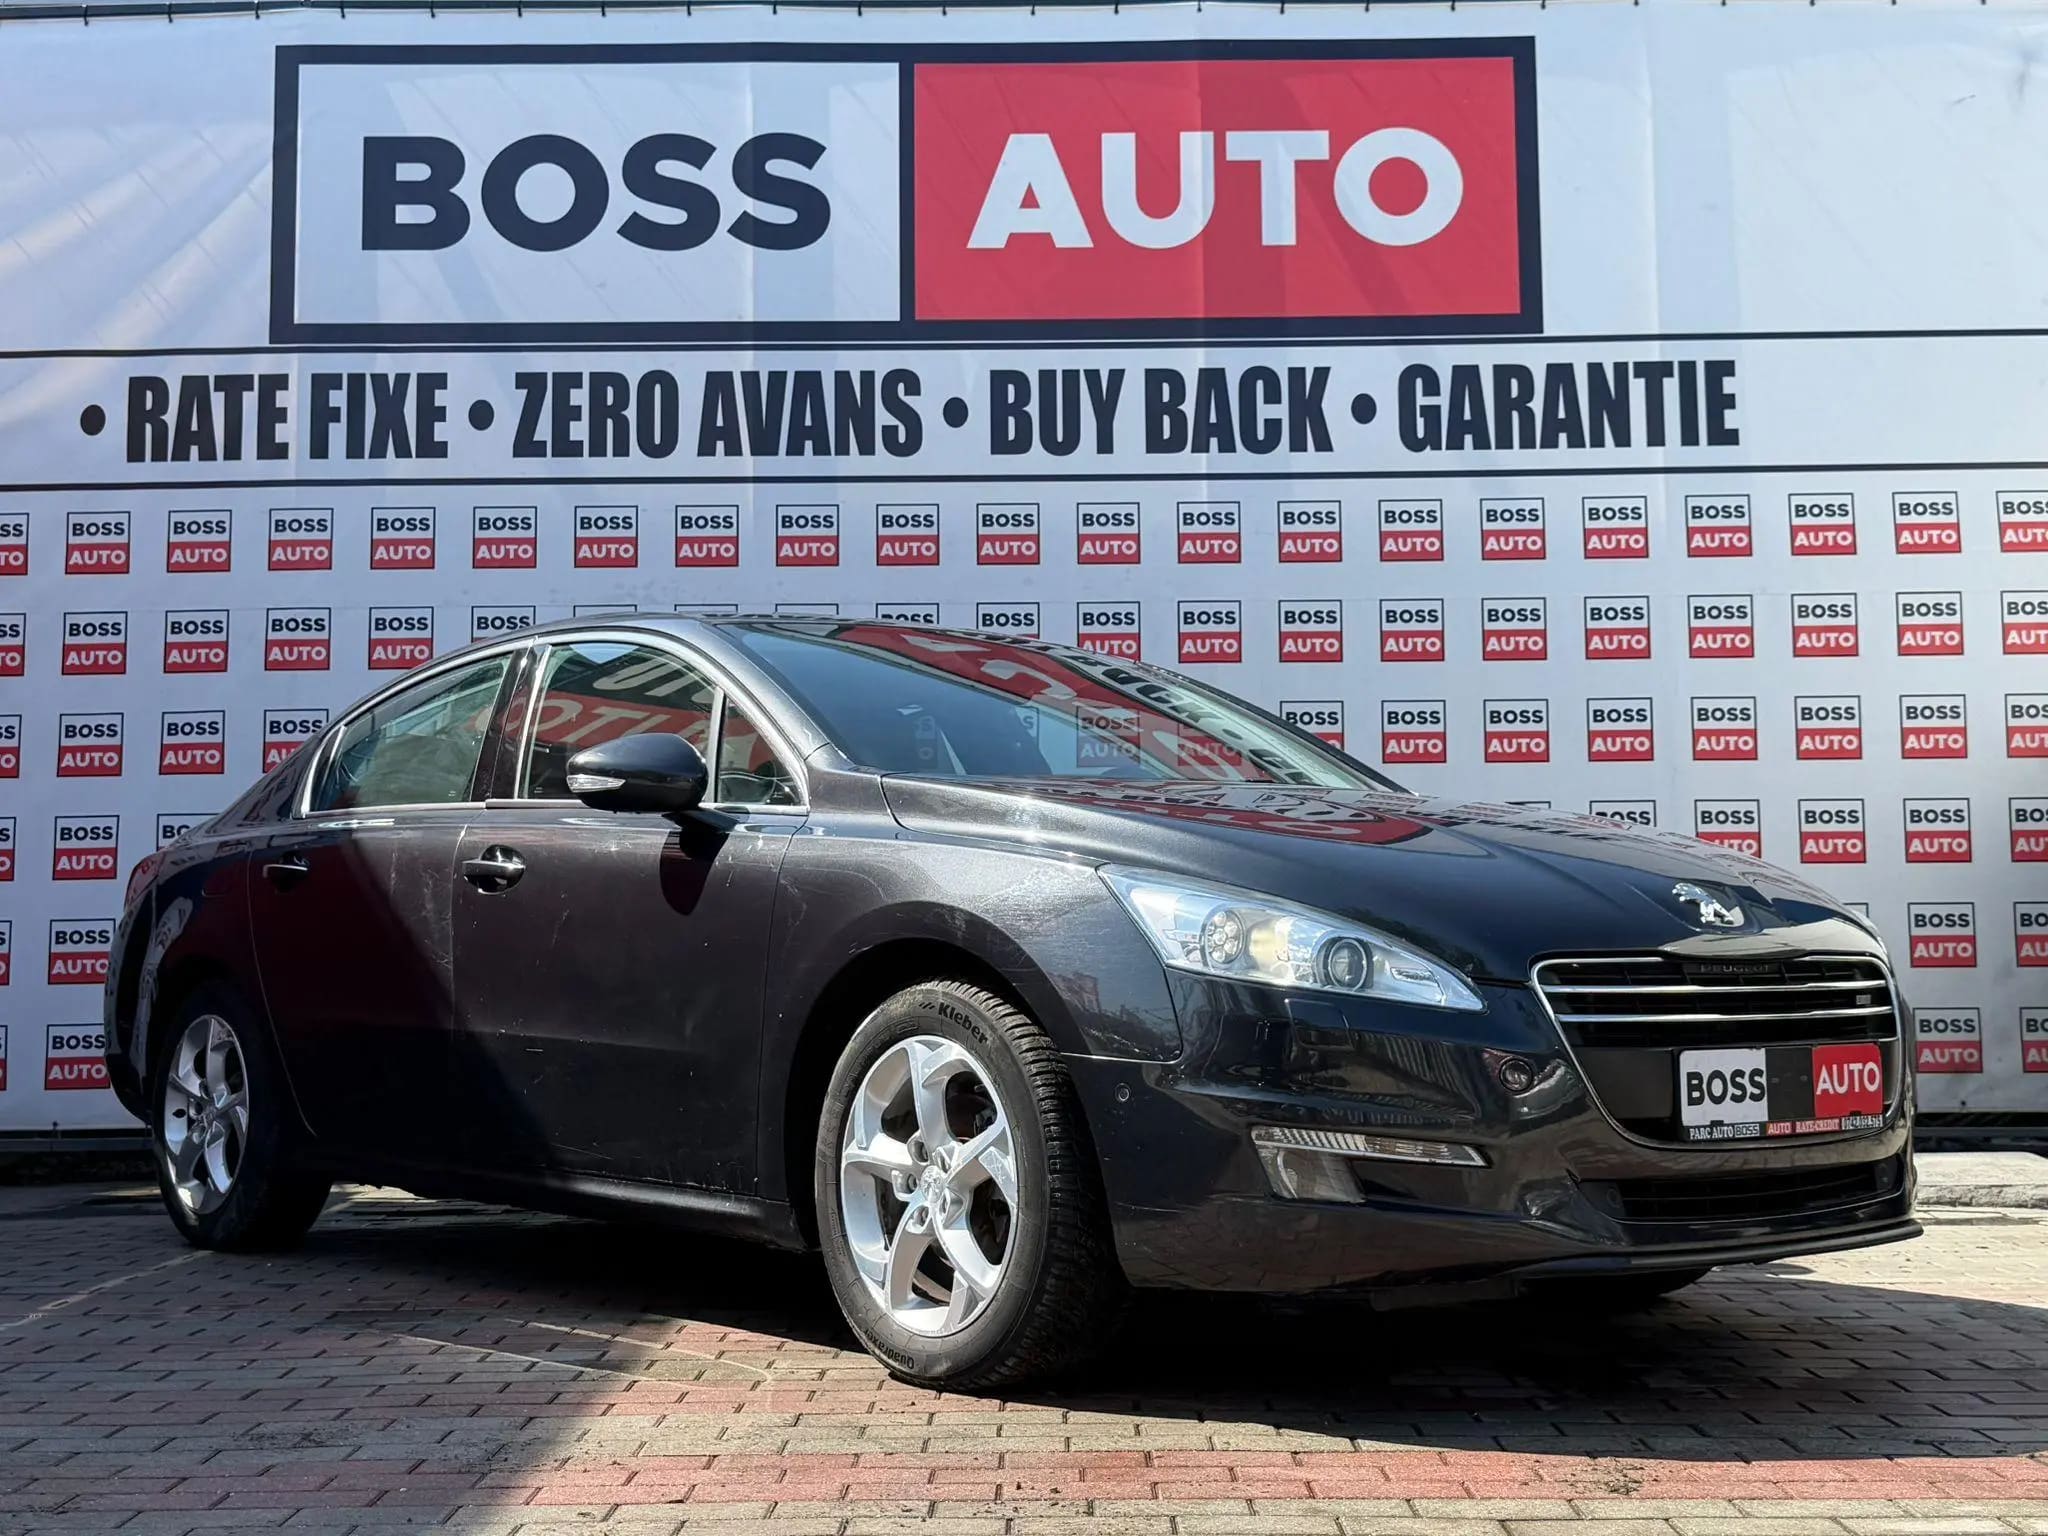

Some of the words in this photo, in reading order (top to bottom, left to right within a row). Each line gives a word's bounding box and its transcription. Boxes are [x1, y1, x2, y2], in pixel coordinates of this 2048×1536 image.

[362, 133, 830, 251] BOSS
[967, 128, 1463, 248] AUTO
[127, 374, 289, 463] RATE
[310, 373, 448, 459] FIXE
[513, 370, 679, 458] ZERO
[697, 369, 922, 457] AVANS
[990, 369, 1125, 456] BUY
[1145, 366, 1333, 454] BACK
[1399, 360, 1739, 452] GARANTIE
[1486, 509, 1539, 522] BOSS
[1589, 507, 1642, 521] BOSS
[1692, 505, 1745, 519] BOSS
[1795, 504, 1849, 517] BOSS
[1899, 502, 1953, 516] BOSS
[479, 517, 532, 530] BOSS
[580, 516, 633, 530] BOSS
[681, 516, 733, 529] BOSS
[782, 515, 834, 528] BOSS
[882, 514, 934, 528] BOSS
[982, 514, 1034, 527] BOSS
[1083, 513, 1135, 526] BOSS
[1183, 512, 1235, 525] BOSS
[1284, 511, 1336, 524] BOSS
[1385, 510, 1437, 523] BOSS
[0, 524, 24, 538] SS
[73, 522, 124, 536] BOSS
[174, 520, 226, 534] BOSS
[275, 519, 328, 532] BOSS
[377, 518, 430, 531] BOSS
[1485, 536, 1542, 550] AUTO
[1587, 535, 1644, 549] AUTO
[1691, 533, 1748, 547] AUTO
[1795, 532, 1852, 546] AUTO
[1899, 530, 1957, 544] AUTO
[477, 545, 533, 558] AUTO
[578, 544, 634, 558] AUTO
[679, 543, 735, 557] AUTO
[780, 543, 835, 556] AUTO
[880, 542, 936, 556] AUTO
[981, 541, 1036, 555] AUTO
[1081, 541, 1136, 554] AUTO
[1181, 540, 1237, 554] AUTO
[1282, 539, 1338, 553] AUTO
[1384, 538, 1440, 551] AUTO
[0, 552, 24, 566] TO
[69, 550, 126, 564] AUTO
[171, 549, 227, 563] AUTO
[272, 547, 328, 560] AUTO
[374, 546, 431, 560] AUTO
[1488, 608, 1541, 622] BOSS
[1590, 607, 1644, 621] BOSS
[1694, 605, 1747, 619] BOSS
[1798, 604, 1852, 618] BOSS
[1902, 603, 1957, 616] BOSS
[2007, 601, 2048, 615] BOS
[477, 616, 530, 630] BOSS
[982, 613, 1034, 627] BOSS
[1083, 612, 1135, 626] BOSS
[1184, 611, 1236, 624] BOSS
[1285, 610, 1337, 624] BOSS
[1386, 609, 1438, 623] BOSS
[69, 623, 121, 636] BOSS
[171, 620, 223, 634] BOSS
[272, 618, 325, 632] BOSS
[375, 617, 428, 631] BOSS
[1486, 637, 1543, 651] AUTO
[1589, 635, 1647, 649] AUTO
[1693, 634, 1750, 648] AUTO
[1797, 633, 1855, 647] AUTO
[1901, 631, 1960, 646] AUTO
[2007, 630, 2048, 644] AUT
[1082, 640, 1137, 655] AUTO
[1182, 639, 1238, 653] AUTO
[1283, 639, 1339, 652] AUTO
[1384, 638, 1441, 652] AUTO
[66, 651, 122, 665] AUTO
[168, 648, 224, 663] AUTO
[269, 647, 326, 660] AUTO
[372, 646, 430, 660] AUTO
[1285, 711, 1339, 726] BOSS
[1388, 711, 1440, 725] BOSS
[1490, 710, 1543, 724] BOSS
[1593, 709, 1647, 722] BOSS
[1697, 708, 1751, 721] BOSS
[1801, 707, 1855, 720] BOSS
[1906, 706, 1961, 719] BOSS
[65, 724, 118, 738] BOSS
[167, 721, 219, 736] BOSS
[269, 720, 323, 735] BOSS
[1386, 739, 1442, 753] AUTO
[1488, 738, 1545, 752] AUTO
[1592, 737, 1650, 752] AUTO
[1696, 736, 1754, 750] AUTO
[1800, 735, 1858, 750] AUTO
[1905, 734, 1964, 749] AUTO
[61, 752, 118, 767] AUTO
[163, 750, 220, 765] AUTO
[1701, 811, 1754, 824] BOSS
[1805, 810, 1859, 824] BOSS
[1910, 809, 1965, 823] BOSS
[2015, 808, 2048, 822] BO
[60, 826, 113, 841] BOSS
[1804, 839, 1862, 853] AUTO
[1909, 838, 1967, 853] AUTO
[2015, 837, 2048, 852] AU
[56, 855, 113, 870] AUTO
[1915, 914, 1969, 927] BOSS
[2020, 913, 2048, 927] BO
[55, 930, 109, 945] BOSS
[1914, 943, 1972, 957] AUTO
[52, 959, 108, 975] AUTO
[938, 1002, 989, 1045] Kleber
[1920, 1019, 1975, 1033] BOSS
[52, 1035, 105, 1050] BOSS
[1920, 1048, 1978, 1063] AUTO
[49, 1064, 107, 1080] AUTO
[1686, 1068, 1767, 1107] BOSS
[1816, 1062, 1880, 1095] AUTO
[1689, 1128, 1711, 1140] PARC
[1712, 1126, 1734, 1138] AUTO
[1735, 1124, 1759, 1137] BOSS
[1767, 1122, 1791, 1135] AUTO
